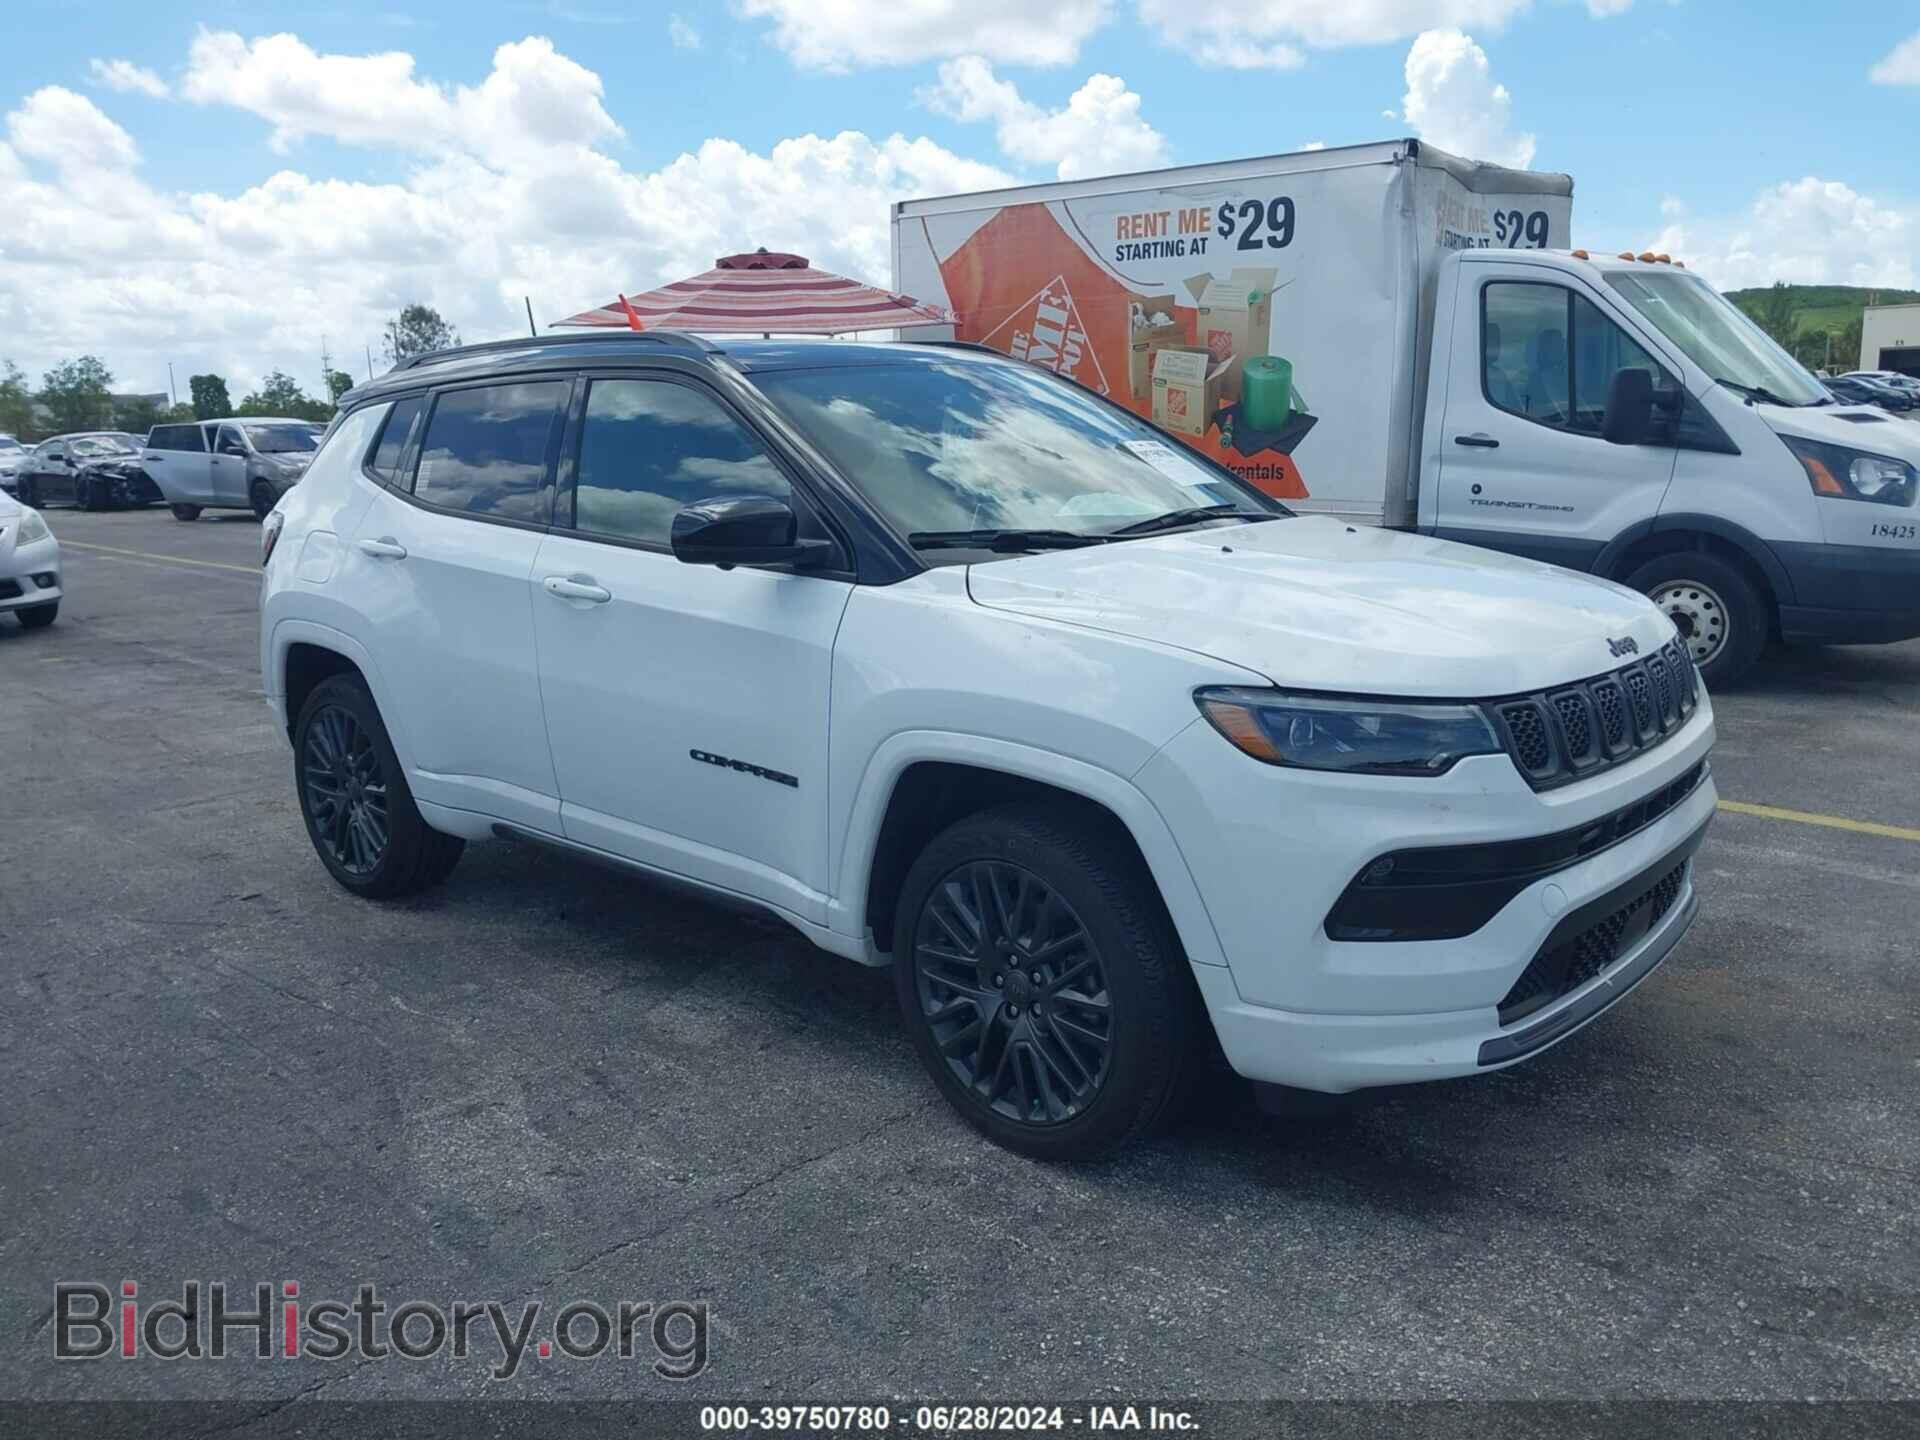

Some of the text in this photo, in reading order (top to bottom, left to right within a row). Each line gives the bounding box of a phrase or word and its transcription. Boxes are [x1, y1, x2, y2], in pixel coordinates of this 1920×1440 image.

[1117, 207, 1212, 240] RENT ME
[1217, 196, 1296, 250] $29
[1493, 208, 1550, 249] $29
[1116, 237, 1209, 262] STARTING AT
[1027, 288, 1073, 372] ME
[1872, 524, 1915, 540] 18425
[1606, 636, 1640, 658] Jeep
[689, 748, 799, 788] COMPASS
